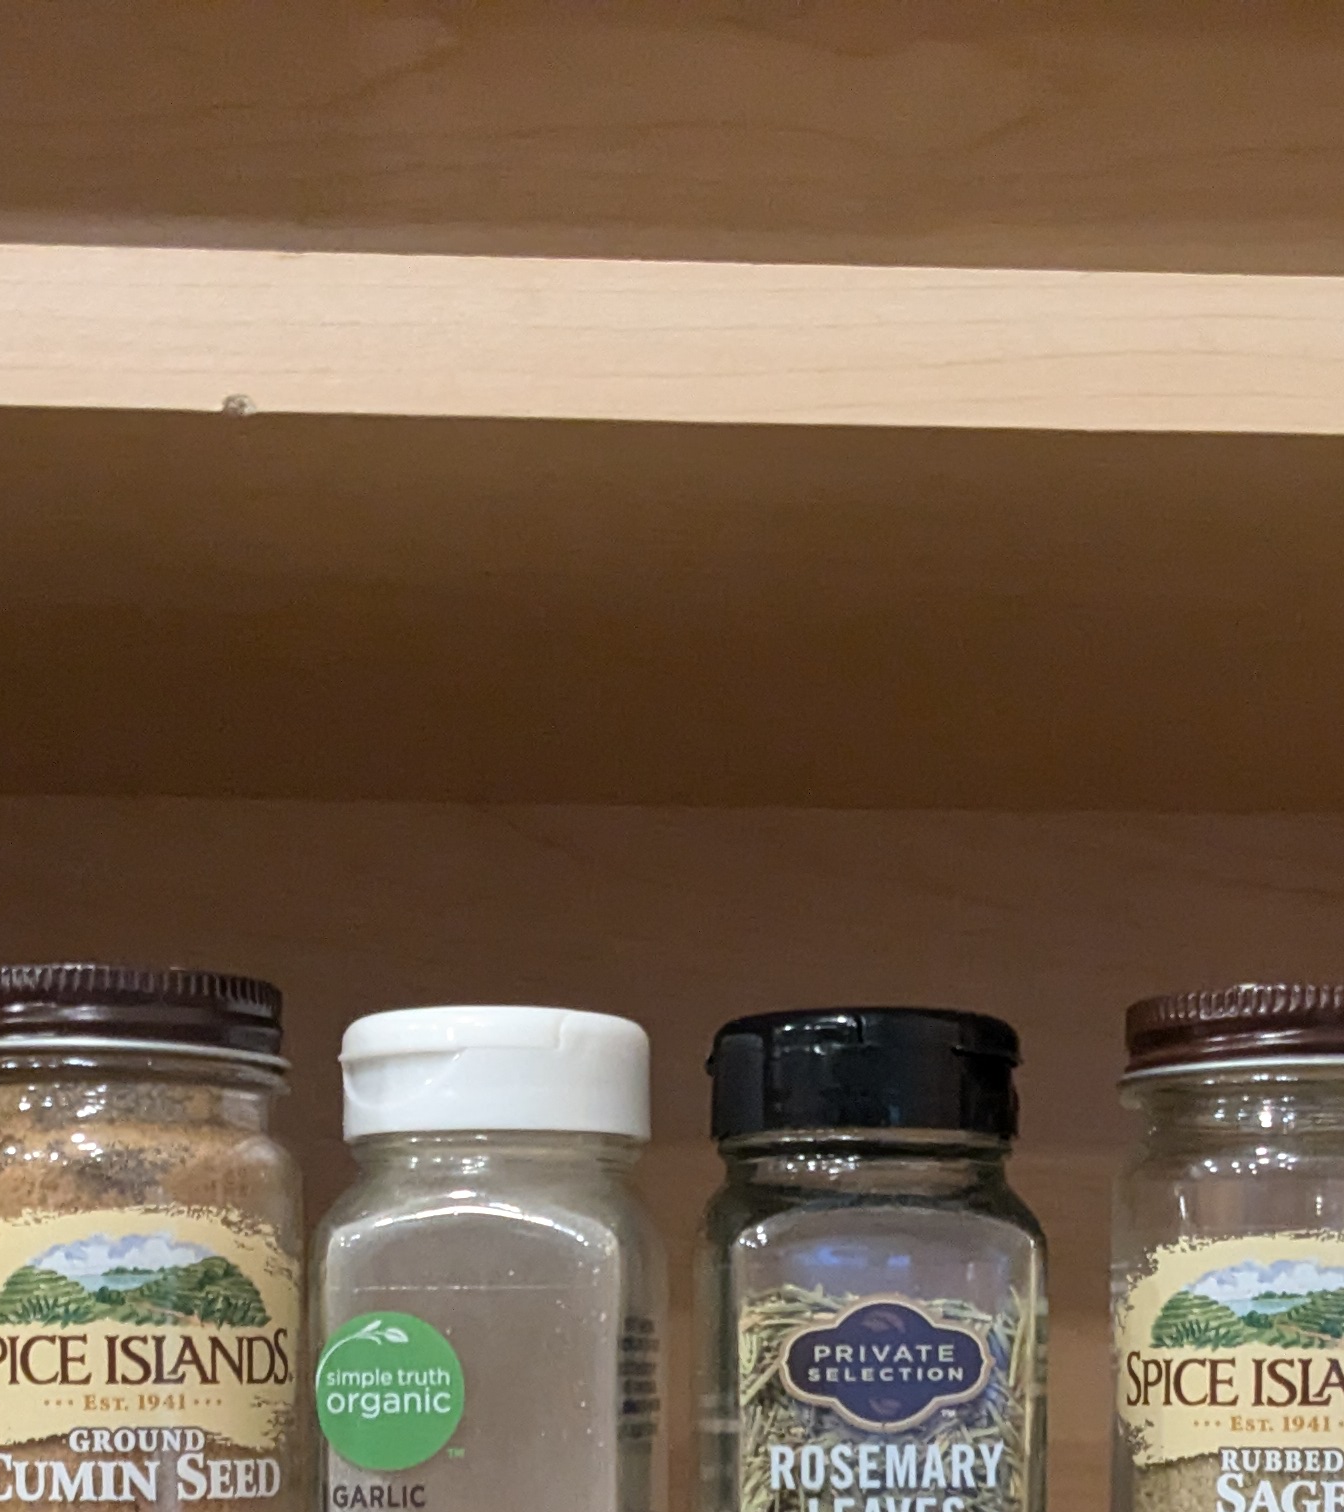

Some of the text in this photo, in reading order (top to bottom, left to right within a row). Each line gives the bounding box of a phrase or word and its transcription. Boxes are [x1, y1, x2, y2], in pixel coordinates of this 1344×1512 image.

[105, 1328, 289, 1385] ISLANDS
[814, 1345, 954, 1362] PRIVATE
[327, 1368, 450, 1388] simple truth
[808, 1367, 964, 1383] SELECTION
[1126, 1351, 1239, 1406] SPICE
[138, 1394, 186, 1411] 1941
[327, 1387, 451, 1420] organic
[1282, 1416, 1331, 1432] 1941
[69, 1428, 205, 1453] GROUND
[769, 1443, 1004, 1491] ROSEMARY
[1220, 1450, 1344, 1472] RUBBED
[176, 1453, 281, 1500] SEED
[332, 1484, 426, 1509] GARLIC
